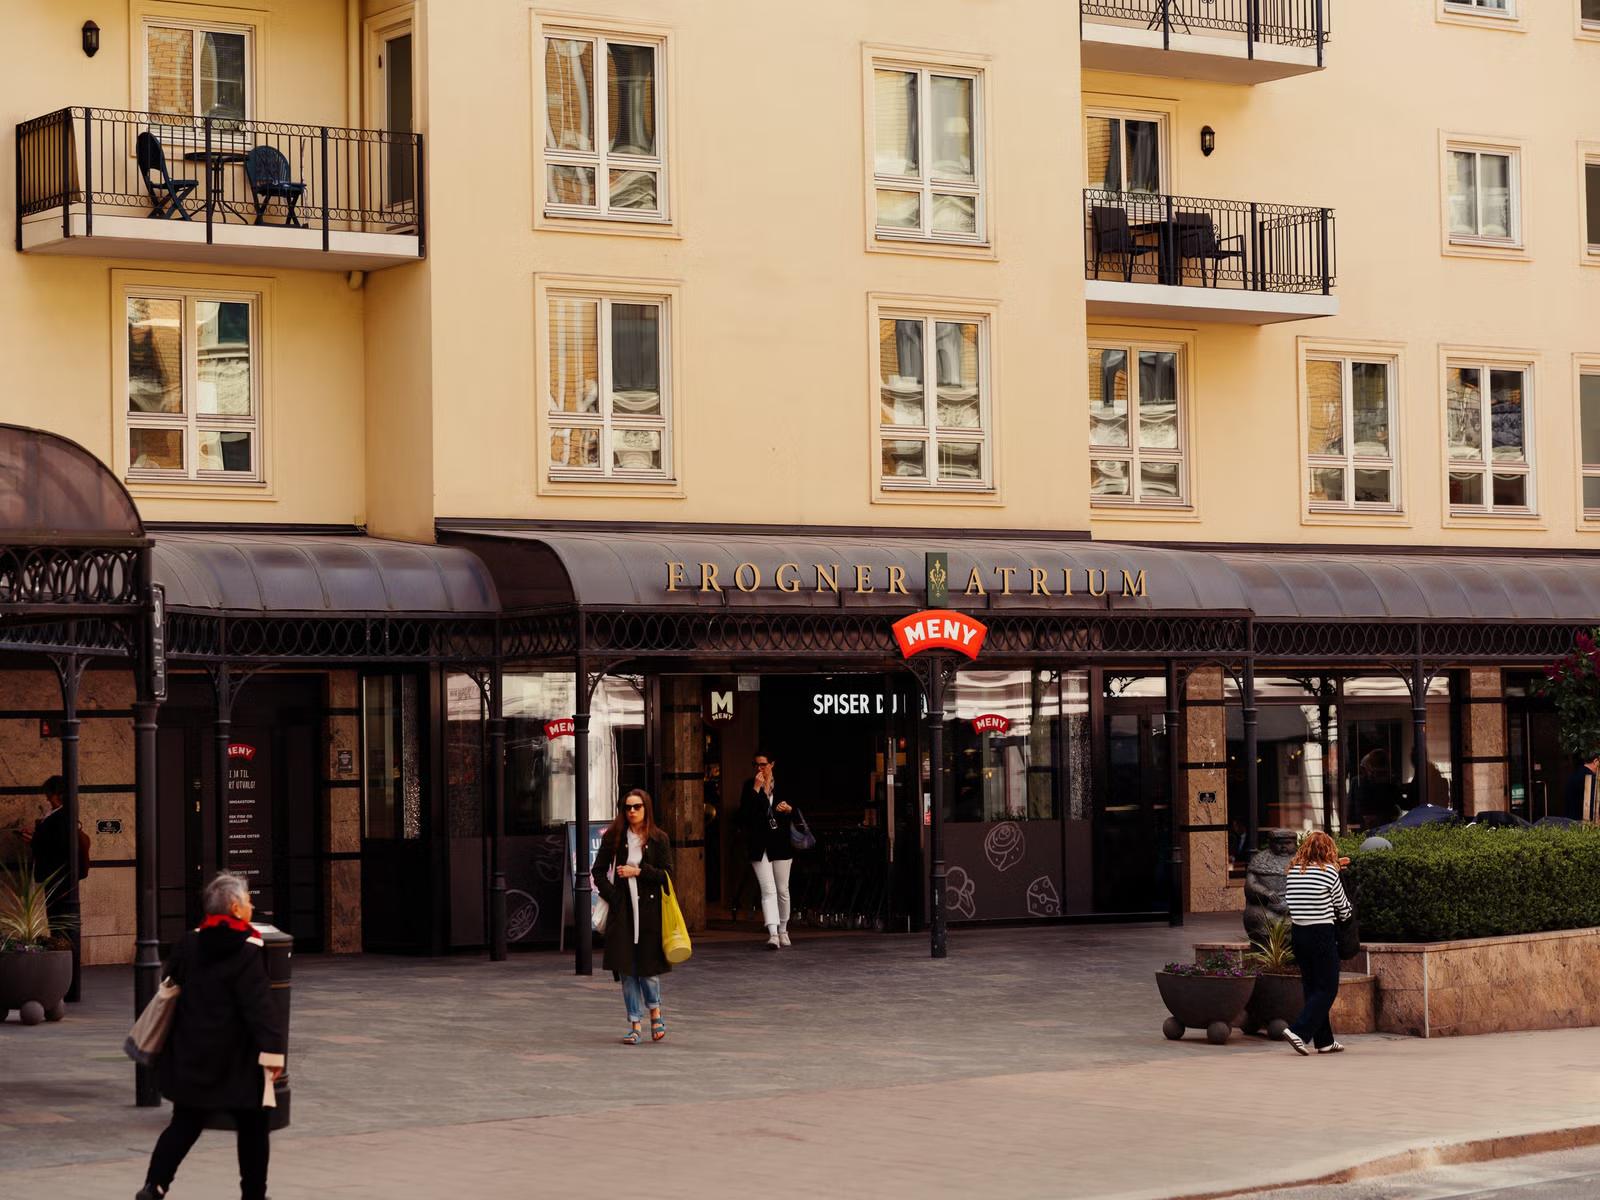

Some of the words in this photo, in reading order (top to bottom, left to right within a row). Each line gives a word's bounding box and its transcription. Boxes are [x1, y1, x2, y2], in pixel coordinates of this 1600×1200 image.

[665, 562, 910, 594] FROGNER
[963, 566, 1149, 597] ATRIUM
[903, 618, 978, 646] MENY
[812, 693, 870, 715] SPISER
[711, 713, 734, 721] MENY
[976, 717, 1006, 730] MENY
[548, 722, 576, 735] MEN
